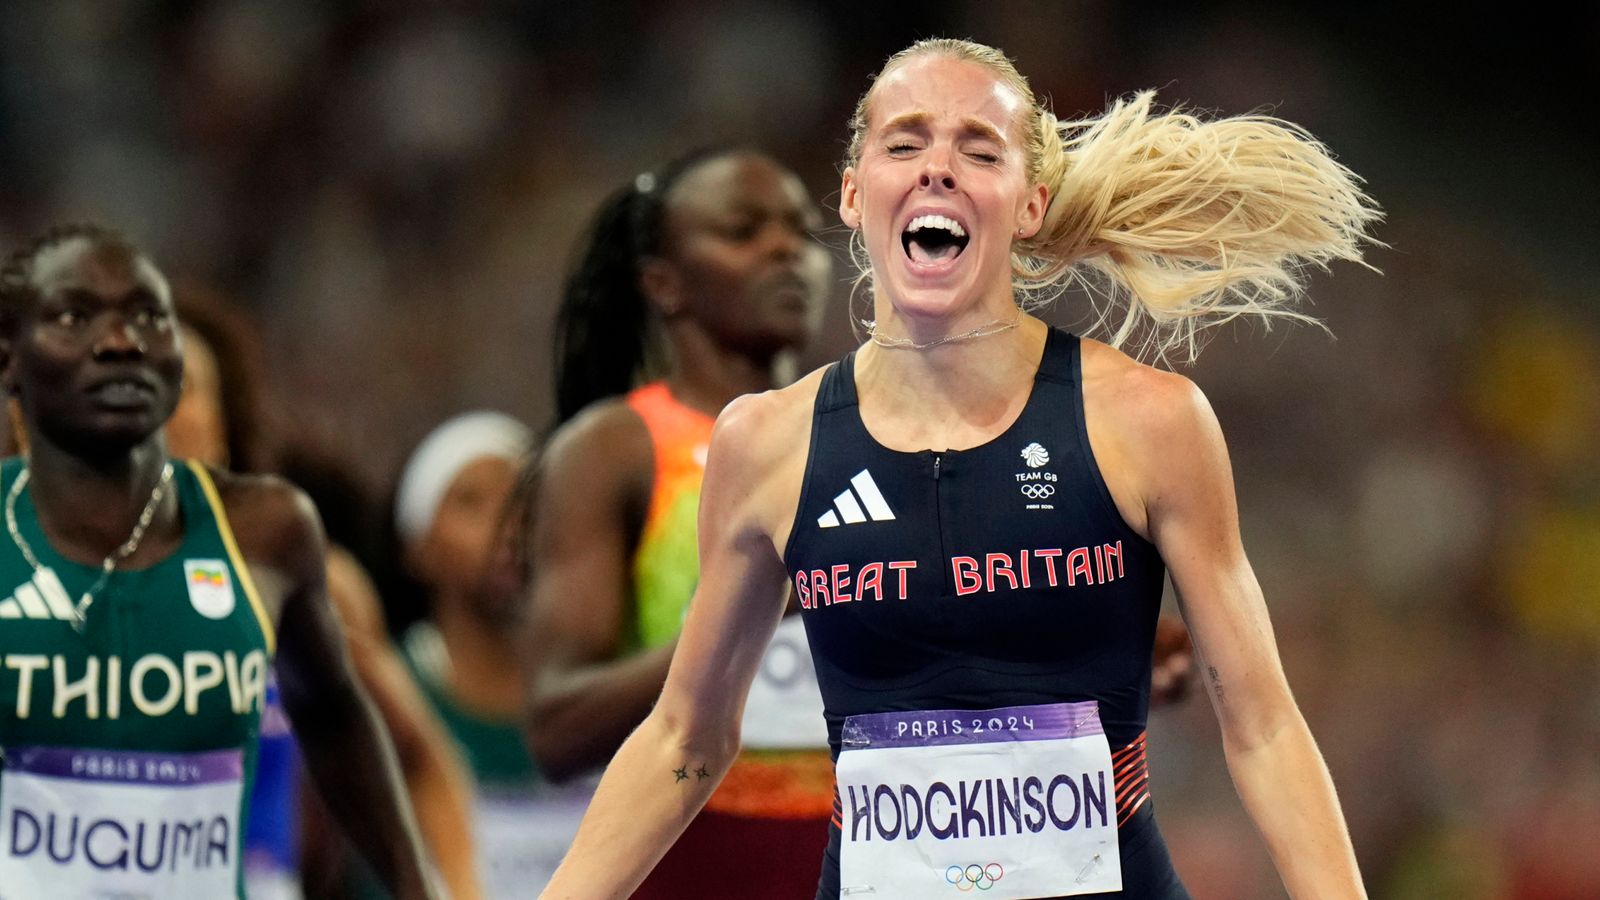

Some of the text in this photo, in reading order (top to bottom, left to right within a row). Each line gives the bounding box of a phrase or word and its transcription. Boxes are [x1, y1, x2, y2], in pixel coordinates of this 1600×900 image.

[1015, 472, 1057, 482] TEAM GB
[795, 540, 1125, 609] GREAT BRITAIN
[0, 650, 266, 719] THIOPIA
[898, 716, 1034, 737] PARIS 2024
[9, 807, 229, 873] DUGUMA
[847, 771, 1108, 842] HODGKINSON
